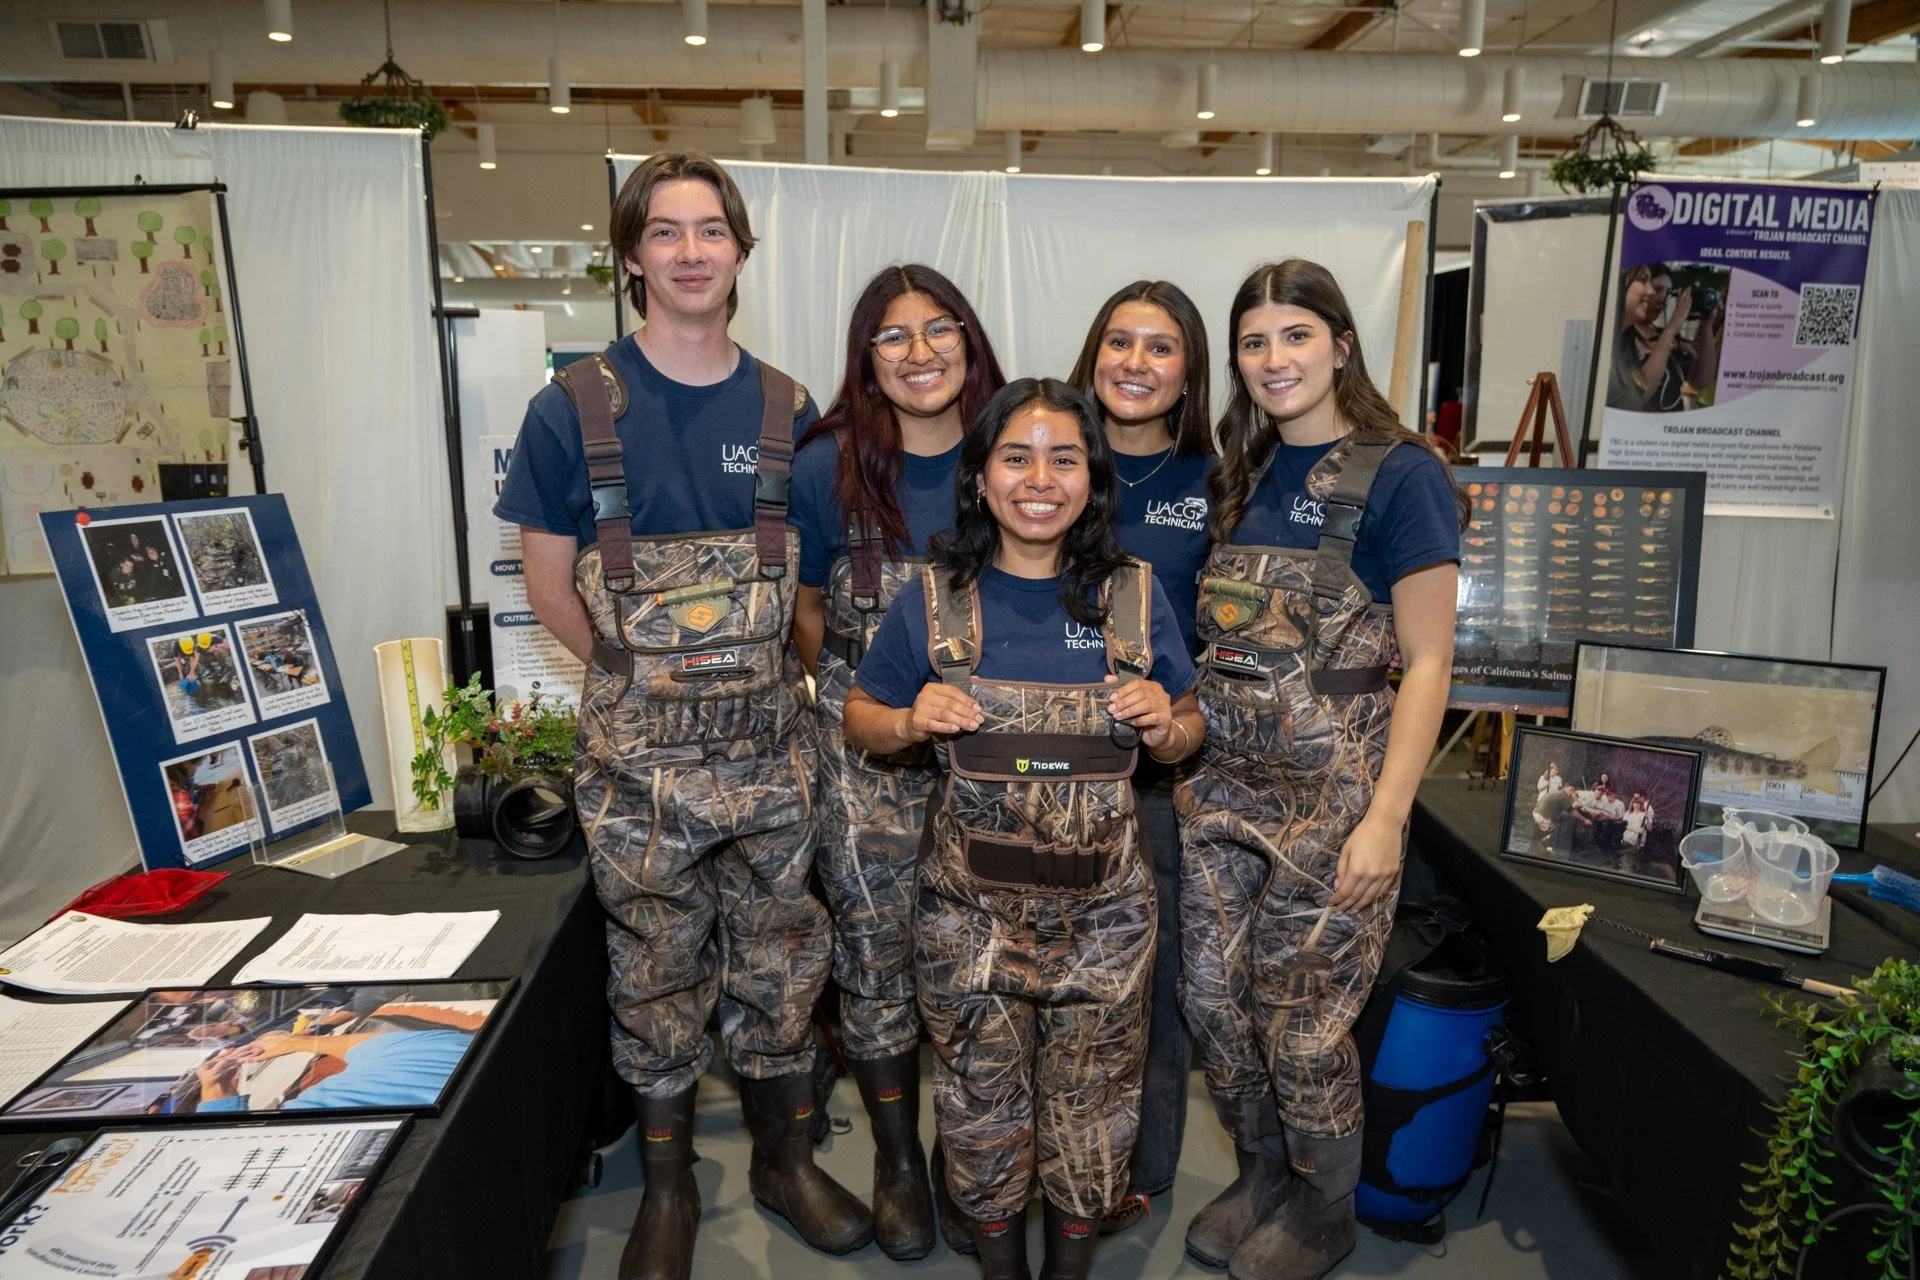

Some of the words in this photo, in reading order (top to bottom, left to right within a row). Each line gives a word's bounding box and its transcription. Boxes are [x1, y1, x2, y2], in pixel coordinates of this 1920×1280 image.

[1672, 192, 1780, 228] DIGITAL
[1787, 194, 1870, 232] MEDIA
[1754, 230, 1785, 242] TROJAN
[1786, 232, 1831, 244] BROADCAST
[1832, 234, 1867, 246] CHANNEL
[1700, 248, 1723, 258] IDEAS.
[1759, 250, 1791, 260] RESULTS.
[1751, 289, 1769, 298] SCAN
[1770, 290, 1779, 298] TO
[1735, 302, 1760, 311] Request
[1722, 370, 1845, 386] www.trojanbroadcast.org
[1663, 425, 1694, 435] TROJAN
[1696, 426, 1742, 436] BROADCAST
[1745, 428, 1781, 438] CHANNEL
[1610, 438, 1622, 446] TBC
[1670, 440, 1690, 448] digital
[722, 444, 759, 464] UAC
[1608, 450, 1622, 458] High
[722, 462, 758, 474] TECHN
[1146, 500, 1197, 520] UACG
[1293, 496, 1326, 518] UAC
[1144, 514, 1205, 532] TECHNICIAN
[1289, 510, 1324, 527] TECHN
[496, 564, 516, 572] HOW
[1065, 622, 1104, 639] UAC
[1064, 639, 1106, 650] TECHN
[684, 653, 735, 668] HISEA
[1216, 650, 1255, 666] HISEA
[1452, 666, 1468, 676] ges
[1470, 665, 1482, 674] of
[1483, 664, 1539, 679] California's
[1540, 670, 1572, 682] Salmo
[0, 1204, 51, 1255] ork?
